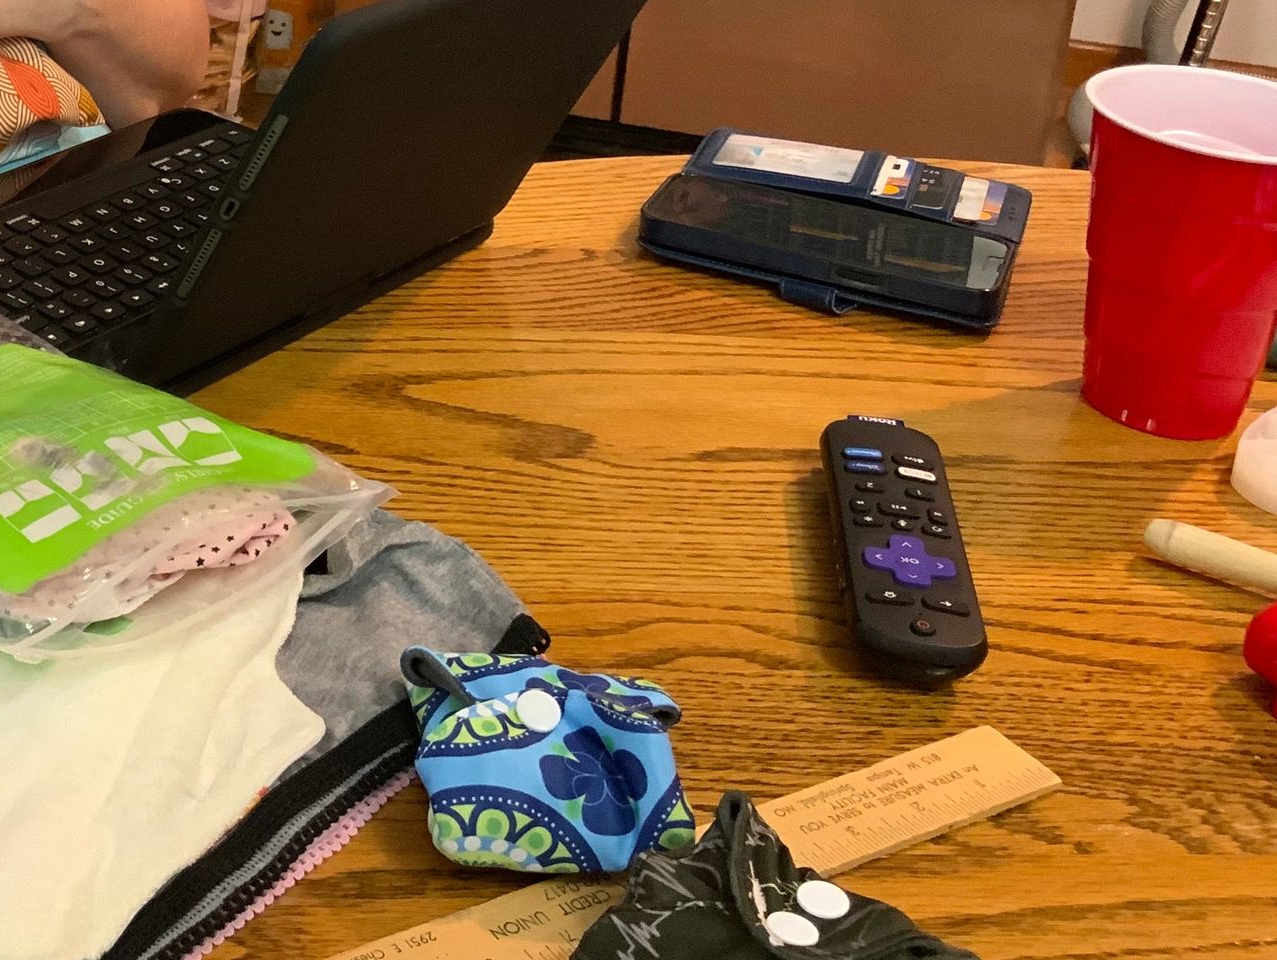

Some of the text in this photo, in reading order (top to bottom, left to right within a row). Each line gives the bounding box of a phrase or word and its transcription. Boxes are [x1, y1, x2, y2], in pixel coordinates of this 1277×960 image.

[900, 556, 920, 565] OK
[921, 753, 942, 765] 815
[907, 762, 921, 771] W
[866, 768, 902, 782] Tampa
[799, 764, 979, 835] An EXTRA MEASURE to SERVE YOU
[830, 777, 908, 811] MAIN FACILITY
[774, 804, 796, 817] MO
[558, 889, 612, 916] CREDIT
[488, 911, 551, 940] UNION
[405, 931, 437, 949] 2951
[391, 943, 402, 953] E
